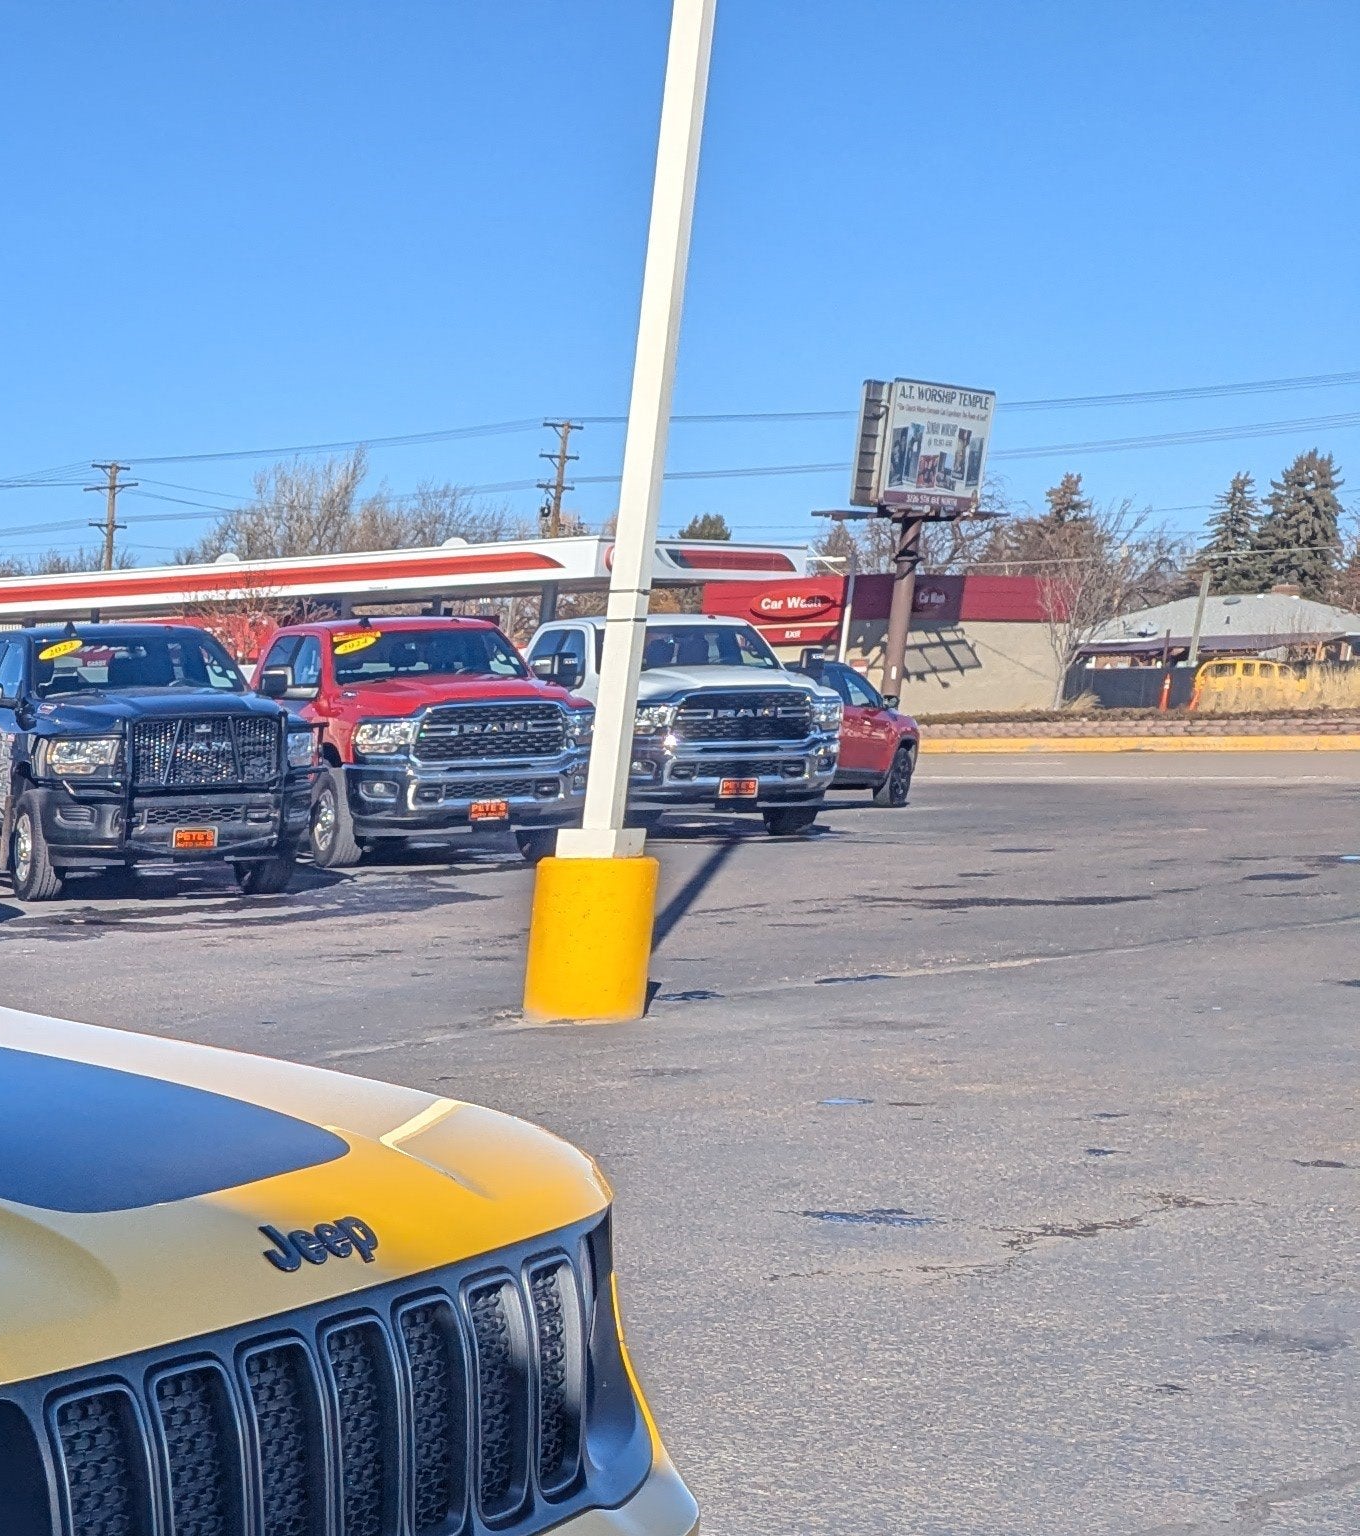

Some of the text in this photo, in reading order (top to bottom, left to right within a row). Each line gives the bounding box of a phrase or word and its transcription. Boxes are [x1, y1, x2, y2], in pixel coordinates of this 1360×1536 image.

[918, 386, 957, 405] WORSHIP
[959, 392, 990, 410] TEMPLE
[760, 595, 822, 610] Car Wash
[258, 1215, 379, 1273] Jeep
